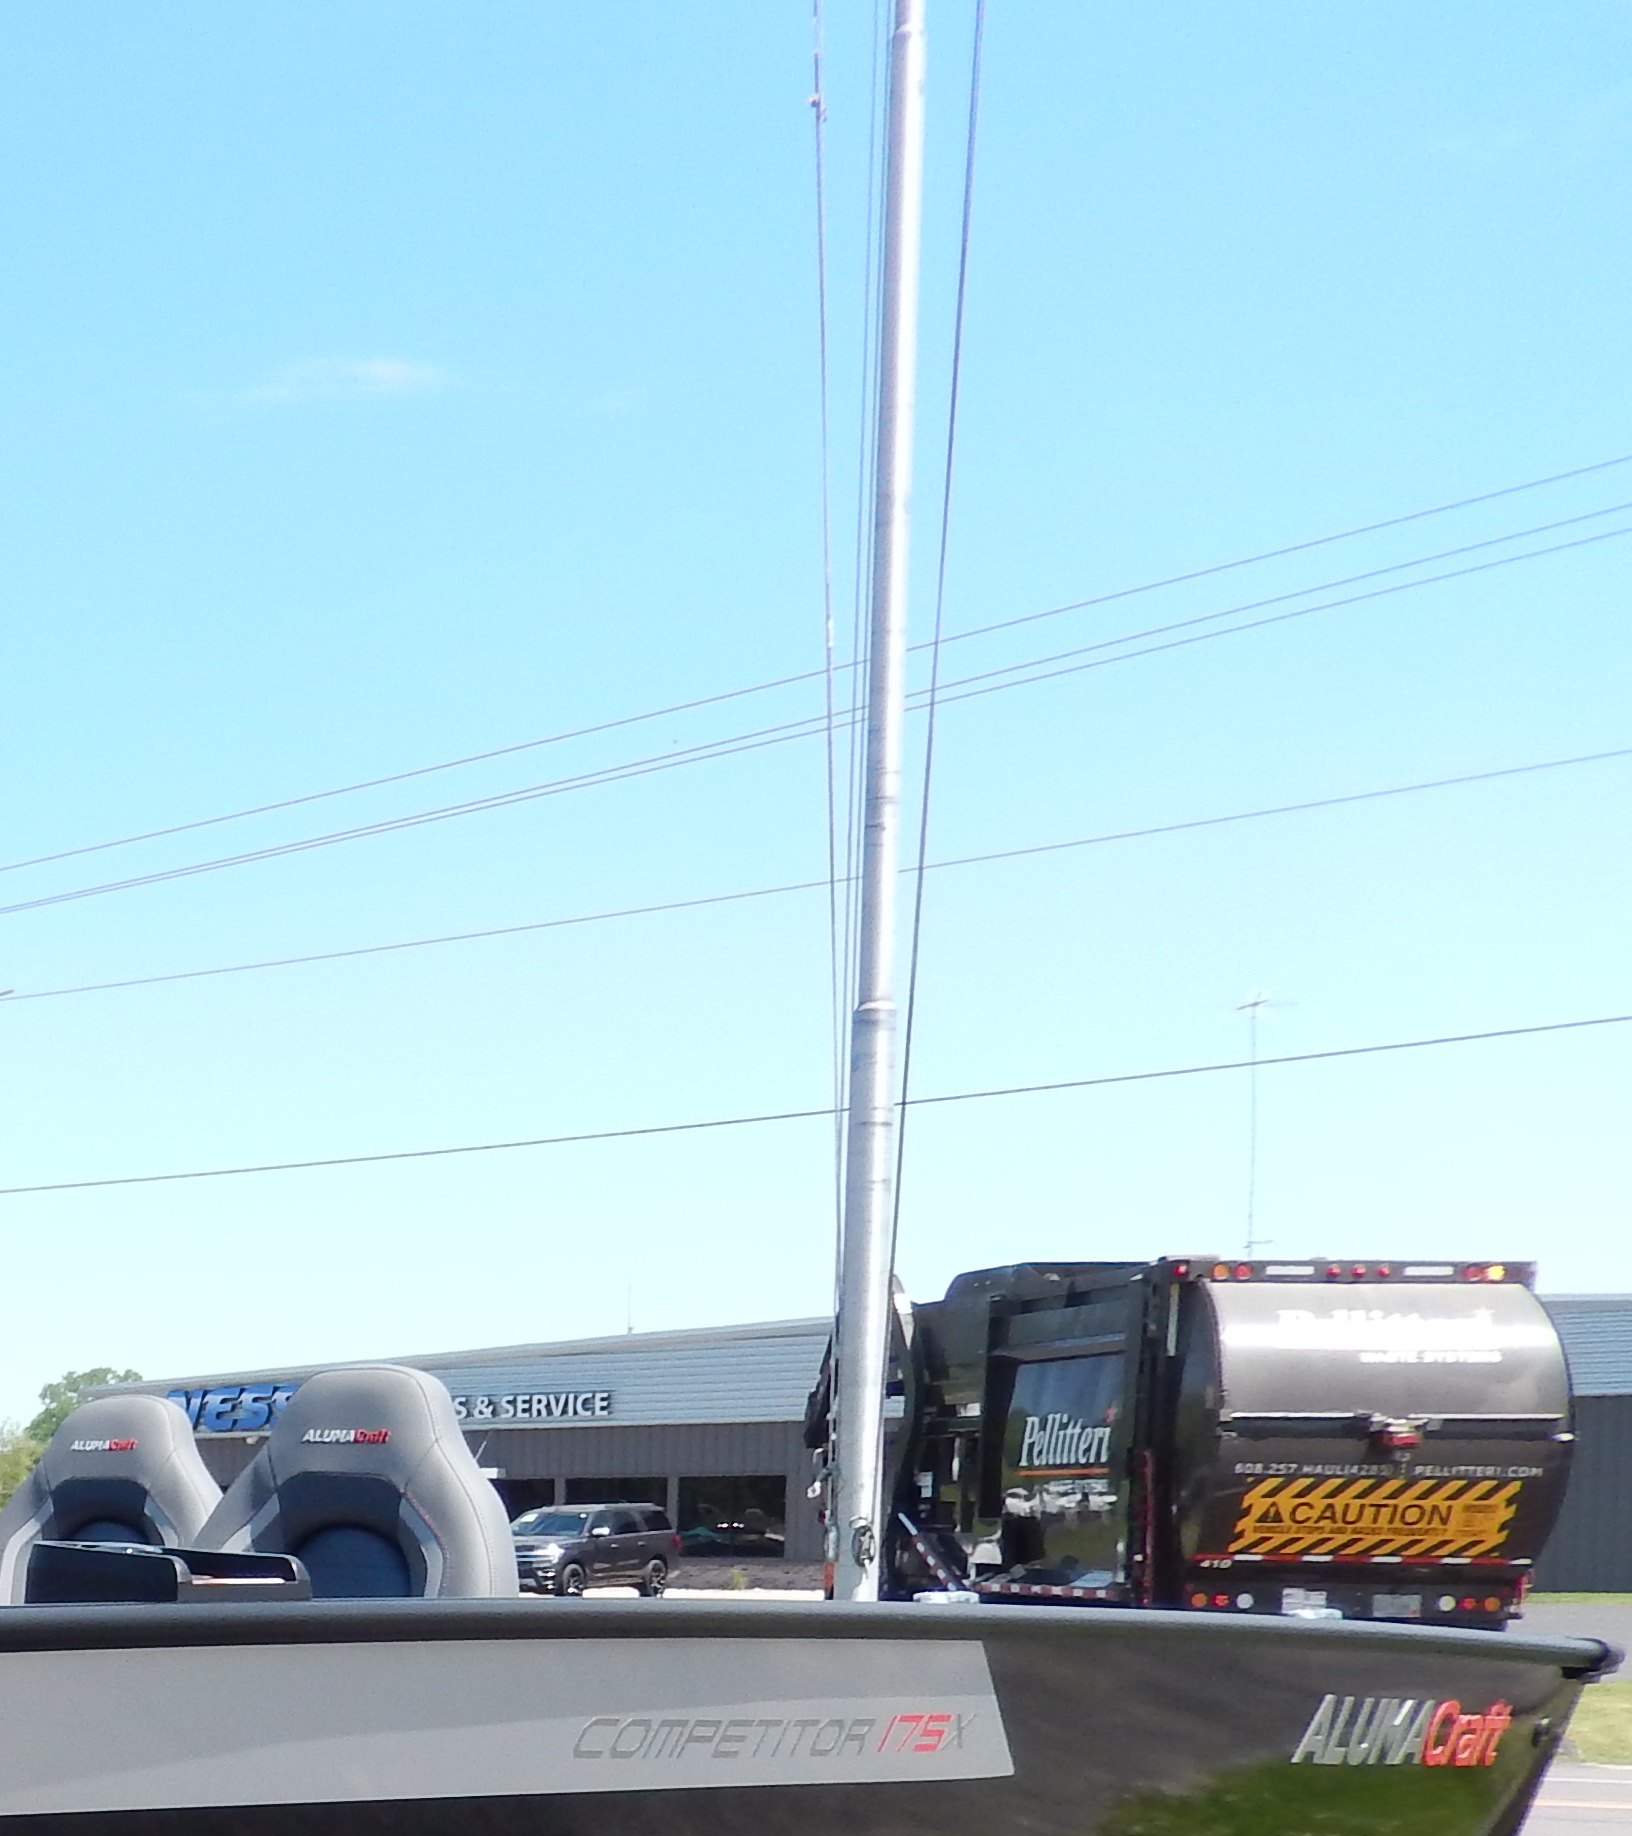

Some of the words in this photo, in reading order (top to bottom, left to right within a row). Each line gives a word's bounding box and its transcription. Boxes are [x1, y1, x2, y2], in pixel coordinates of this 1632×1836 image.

[473, 1396, 494, 1418] &
[500, 1392, 609, 1418] SERVICE
[1289, 1502, 1453, 1526] CAUTION
[1199, 1558, 1233, 1570] 410
[572, 1718, 876, 1760] COMPETITOR
[876, 1712, 976, 1754] 175X
[1291, 1693, 1514, 1767] ALUMACraft
